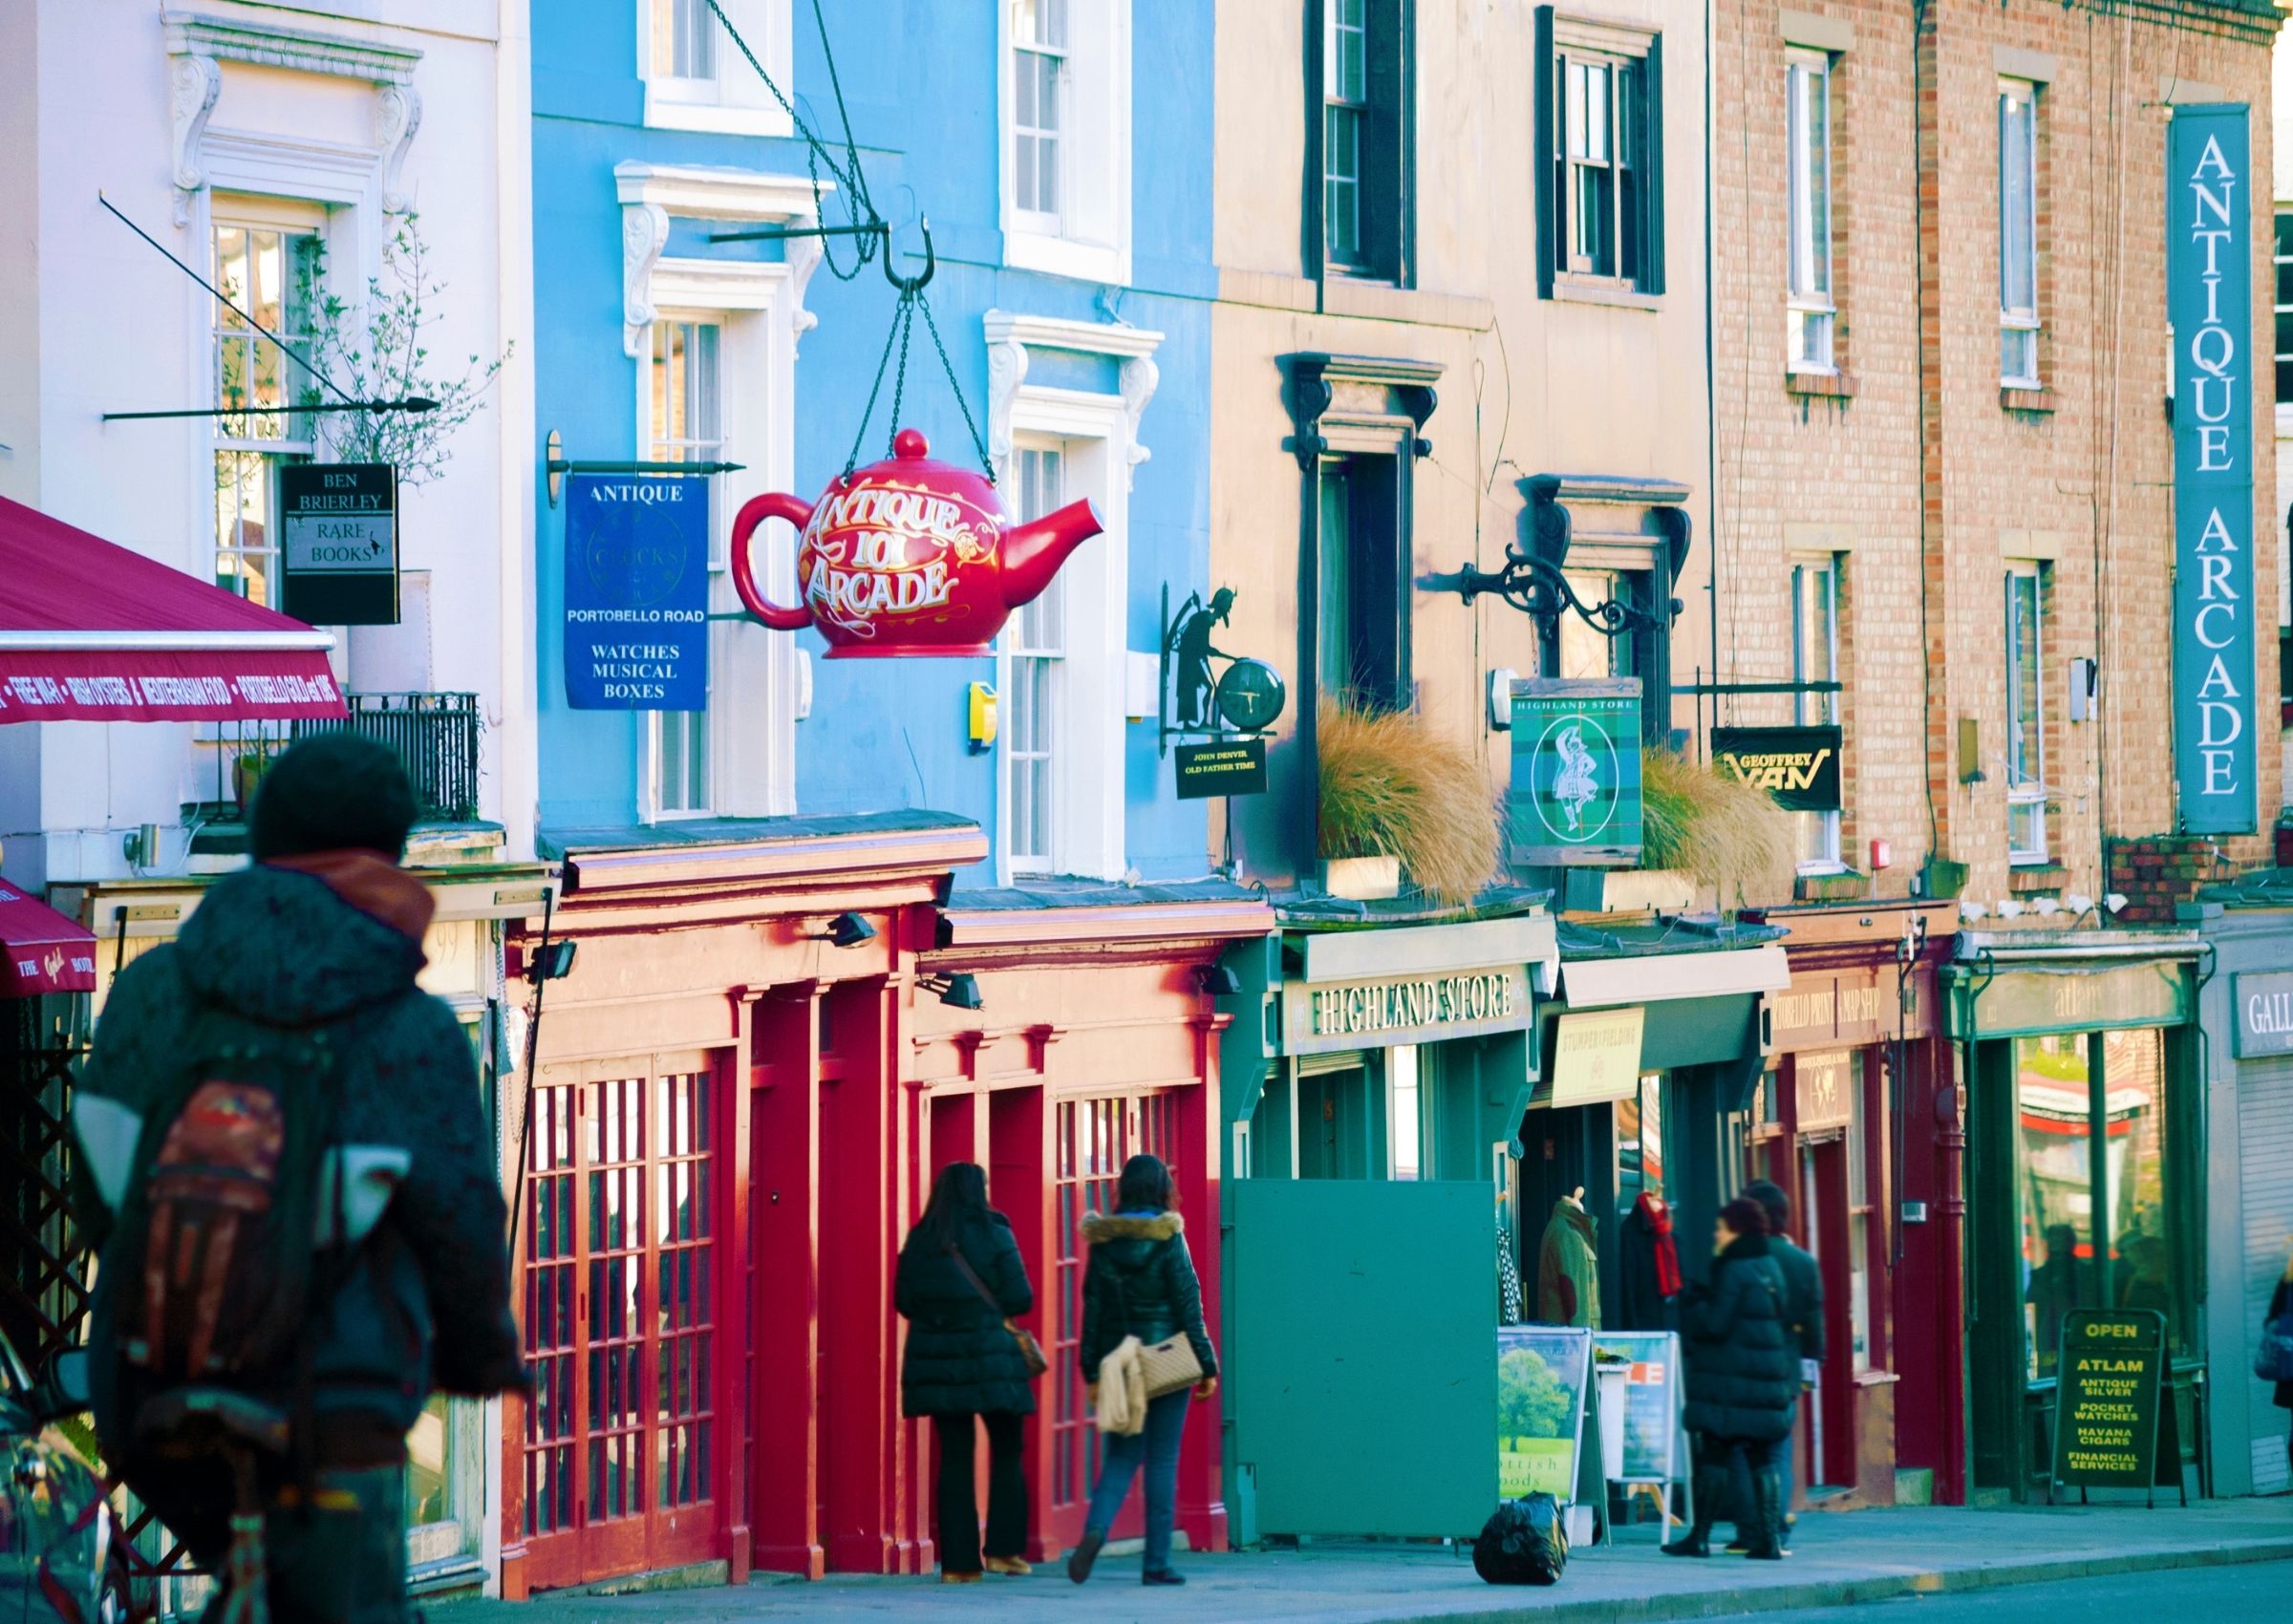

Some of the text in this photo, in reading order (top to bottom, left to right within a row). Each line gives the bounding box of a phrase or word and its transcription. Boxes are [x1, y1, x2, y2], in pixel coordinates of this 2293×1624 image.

[2189, 133, 2242, 795] ANTIQUE ARCADE
[323, 473, 358, 488] BEN
[590, 483, 683, 505] ANTIQUE
[299, 494, 382, 510] BRIERLEY
[801, 478, 969, 550] ANTIQUE
[317, 524, 367, 539] RARE
[311, 546, 373, 562] BOOKS
[805, 555, 958, 619] ARCADE
[568, 609, 705, 623] PORTOBELLO ROAD
[591, 644, 680, 659] WATCHES
[592, 663, 677, 678] MUSICAL
[8, 676, 42, 704] FREE
[86, 677, 134, 705] OYSTERS
[129, 676, 143, 706] &
[201, 676, 232, 705] FOOD
[236, 675, 290, 703] PORTOBELLO
[282, 675, 311, 703] GOLD
[604, 683, 665, 698] BOXES
[1517, 700, 1633, 710] HIGHLAND STORE
[1193, 750, 1248, 761] JOHN DENVER
[1740, 753, 1812, 767] GEOFFREY
[1185, 761, 1255, 775] OLD FATHER TIME
[1724, 748, 1831, 790] VAN
[18, 959, 39, 977] THE
[1318, 981, 1437, 1035] HIGHLAND
[1444, 973, 1511, 1022] STORE
[1772, 993, 1810, 1031] RTOBELLO
[1811, 991, 1835, 1026] PRINT
[1843, 989, 1861, 1023] MAP
[1861, 987, 1881, 1021] SHOP
[2248, 992, 2293, 1035] GALL
[2086, 1324, 2137, 1337] OPEN
[2077, 1359, 2144, 1372] ATLAM
[2079, 1378, 2138, 1388] ANTIQUE
[2085, 1387, 2132, 1397] SILVER
[2080, 1402, 2133, 1413] POCKET
[2074, 1411, 2138, 1421] WATCHES
[2077, 1427, 2132, 1437] HAVANA
[2080, 1437, 2130, 1445] CIGARS
[2068, 1452, 2138, 1462] FINANCIAL
[2070, 1462, 2136, 1471] SERVICES
[1499, 1472, 1540, 1486] oods
